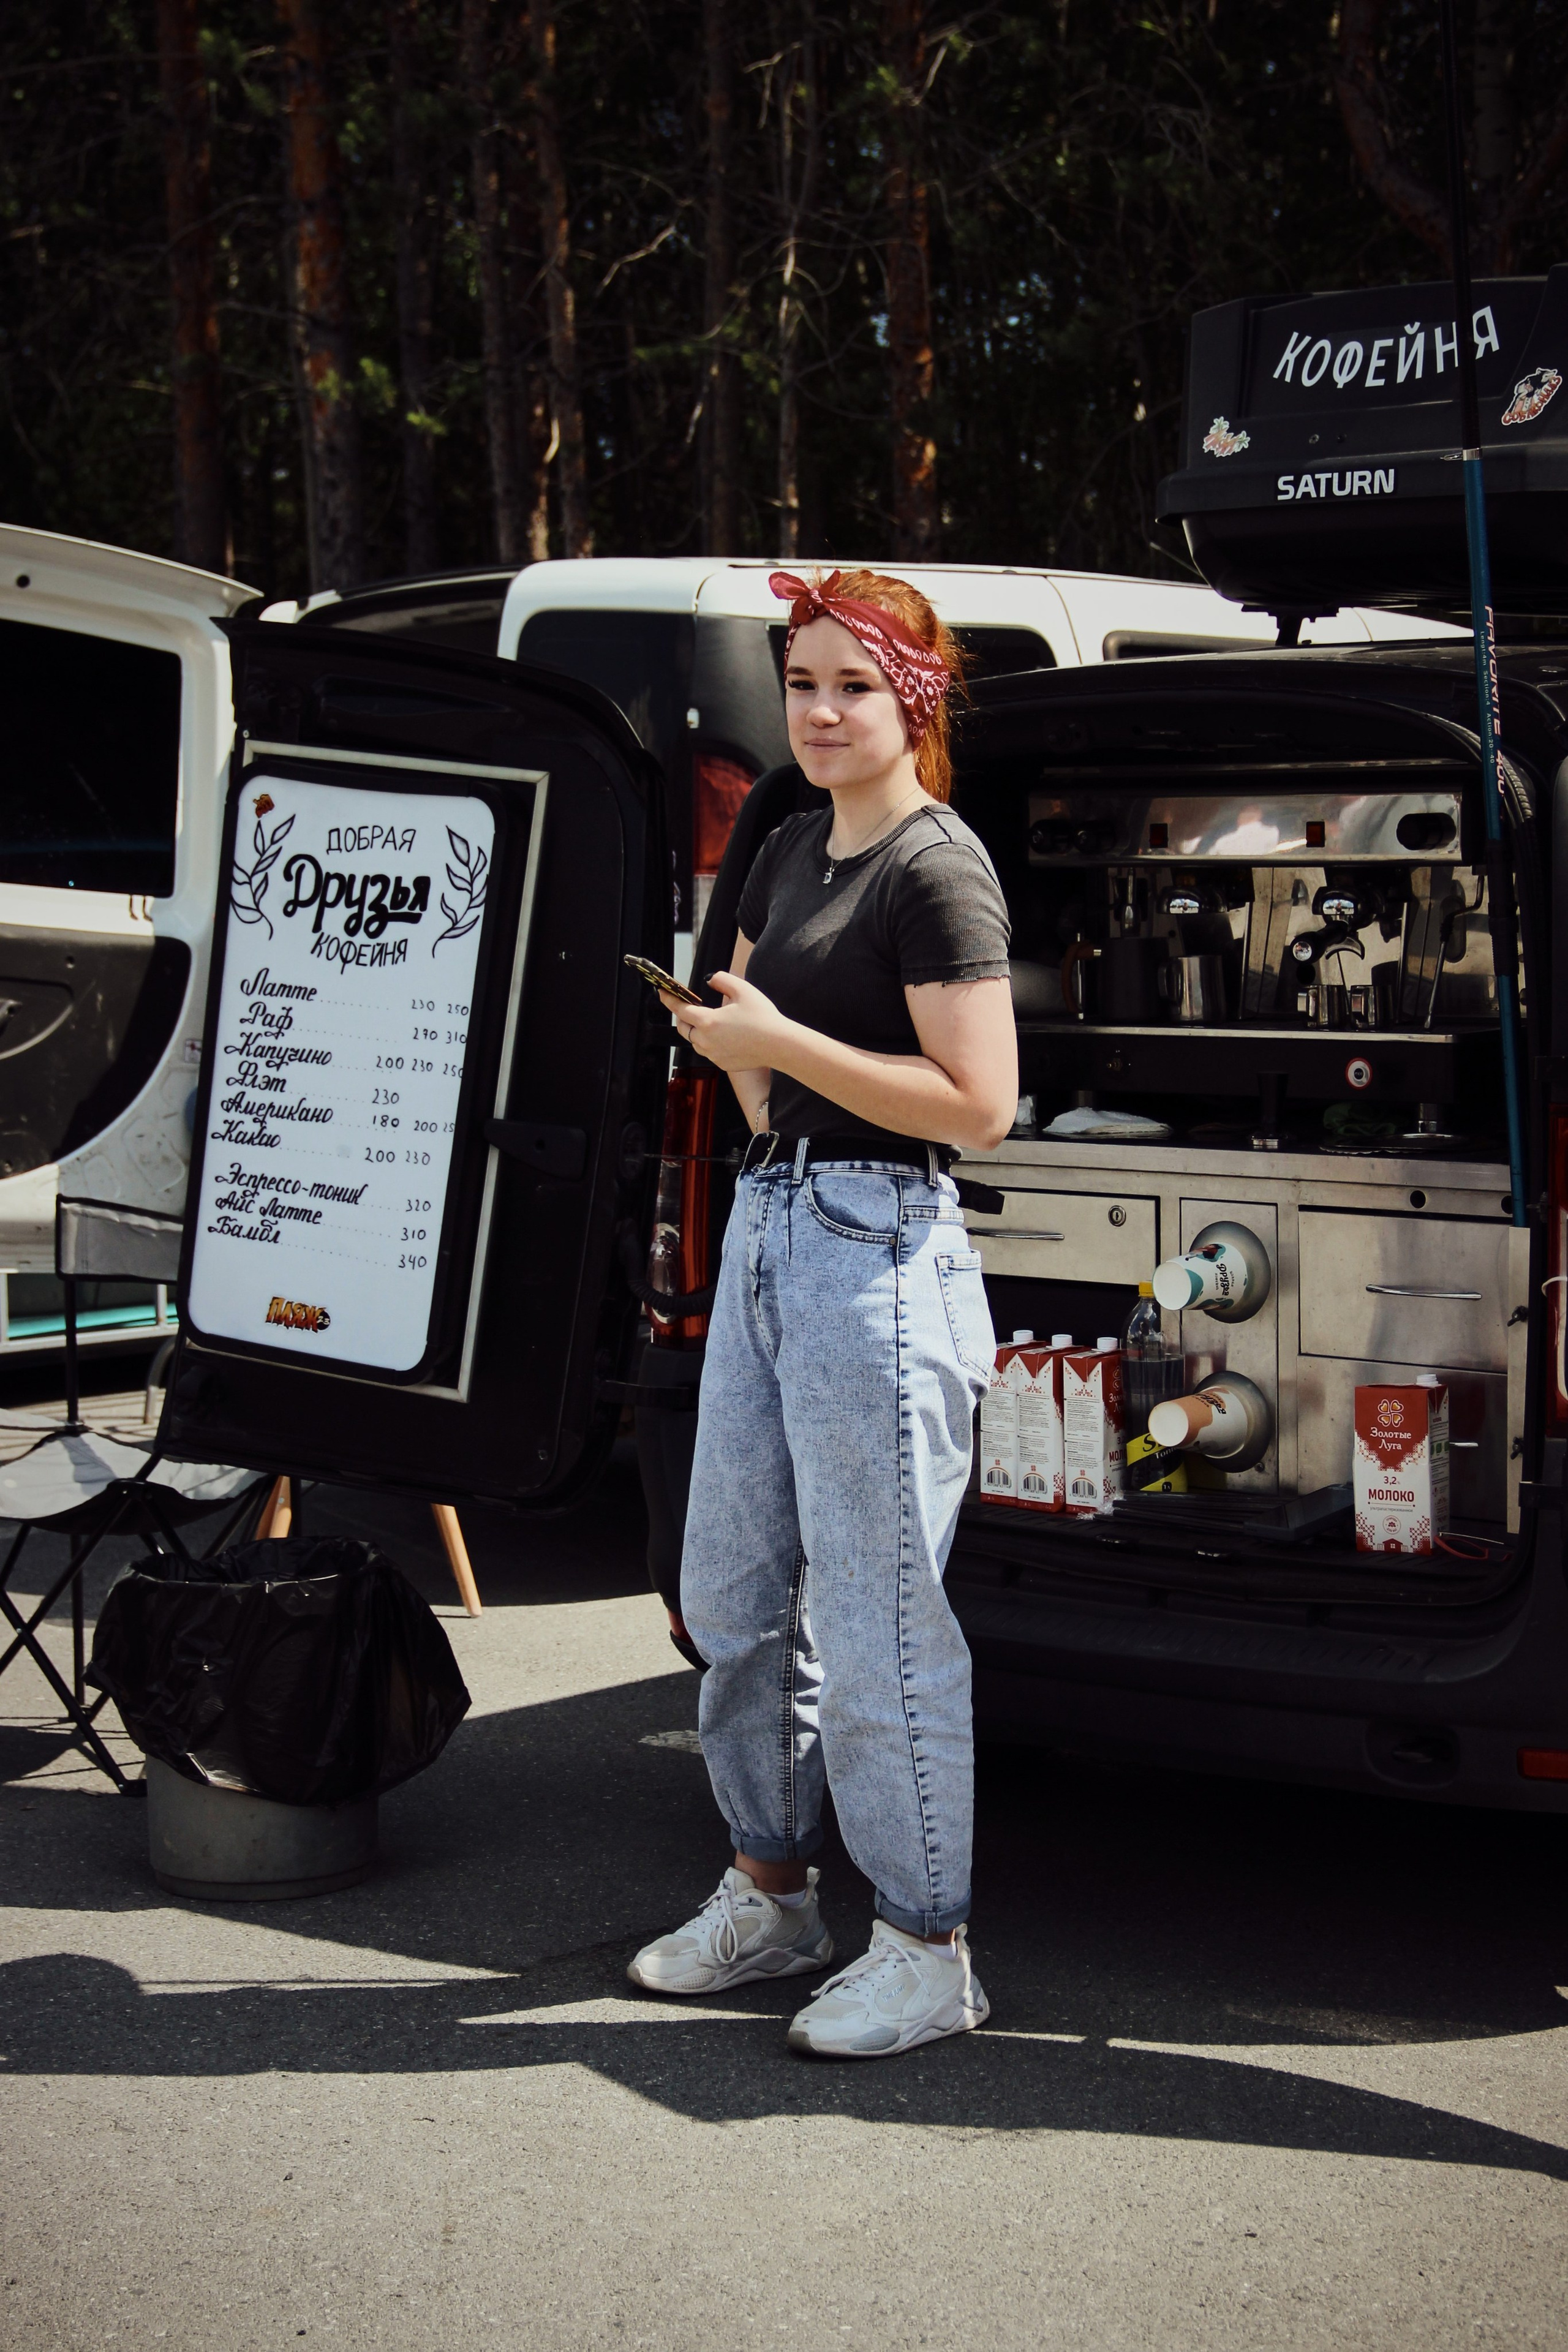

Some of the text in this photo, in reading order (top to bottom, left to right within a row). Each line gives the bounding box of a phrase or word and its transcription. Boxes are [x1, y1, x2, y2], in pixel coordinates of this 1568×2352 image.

[1273, 306, 1500, 388] КОФЕЙНЯ
[1277, 469, 1395, 500] SATURN
[1485, 605, 1501, 735] FAVORITE
[326, 825, 417, 854] ДОБРАЯ
[283, 854, 431, 939] Друзья
[311, 932, 408, 974] КОФЕЙНЯ
[240, 968, 469, 1016] Латте 230 250
[239, 1002, 467, 1044] Раф 270 310
[224, 1032, 332, 1071] Капучино
[375, 1056, 404, 1069] 200
[412, 1059, 433, 1072] 230
[226, 1061, 400, 1105] Флэт 230
[221, 1091, 333, 1127] Американо
[372, 1115, 400, 1129] 180
[413, 1120, 437, 1133] 200
[211, 1120, 431, 1166] Какао 200 230
[215, 1163, 431, 1212] Эспрессо-тоник 320
[216, 1191, 426, 1241] Айс Латте 310
[208, 1216, 427, 1270] Бамбл 340
[1216, 1263, 1230, 1296] Друзья
[1370, 1427, 1412, 1439] Золотые
[1379, 1439, 1402, 1451] Луга
[1368, 1488, 1414, 1502] МОЛОКО
